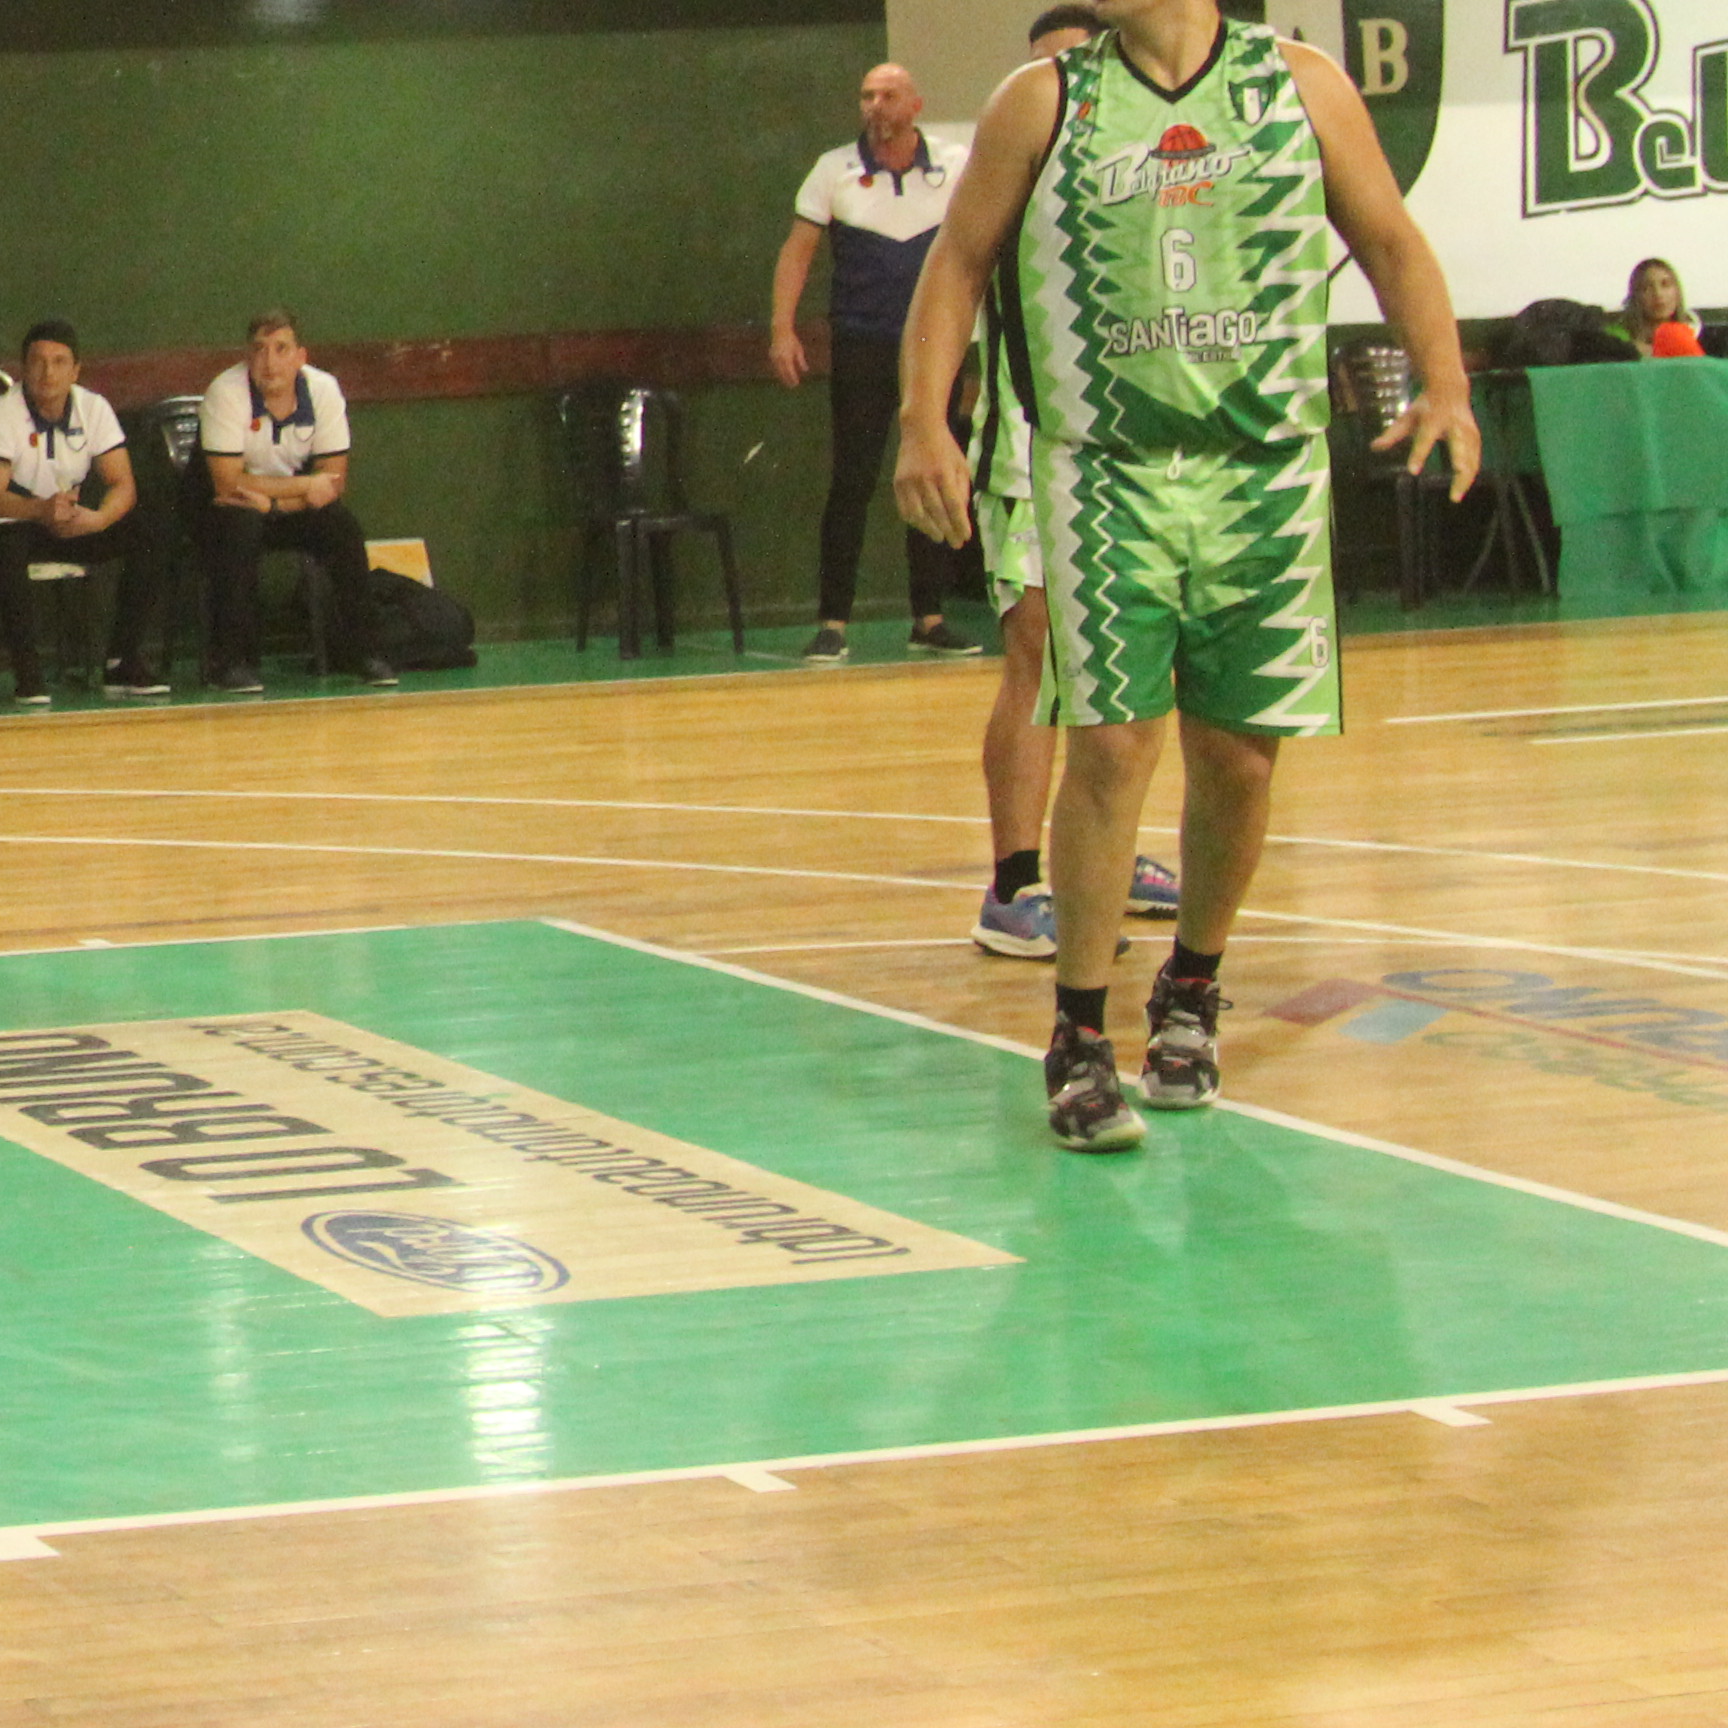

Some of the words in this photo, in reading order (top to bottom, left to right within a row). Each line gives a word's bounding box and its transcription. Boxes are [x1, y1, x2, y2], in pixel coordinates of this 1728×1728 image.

[1160, 227, 1197, 293] 6
[140, 1139, 466, 1205] LO
[194, 1019, 914, 1265] lobrunoautomotores.com.ar
